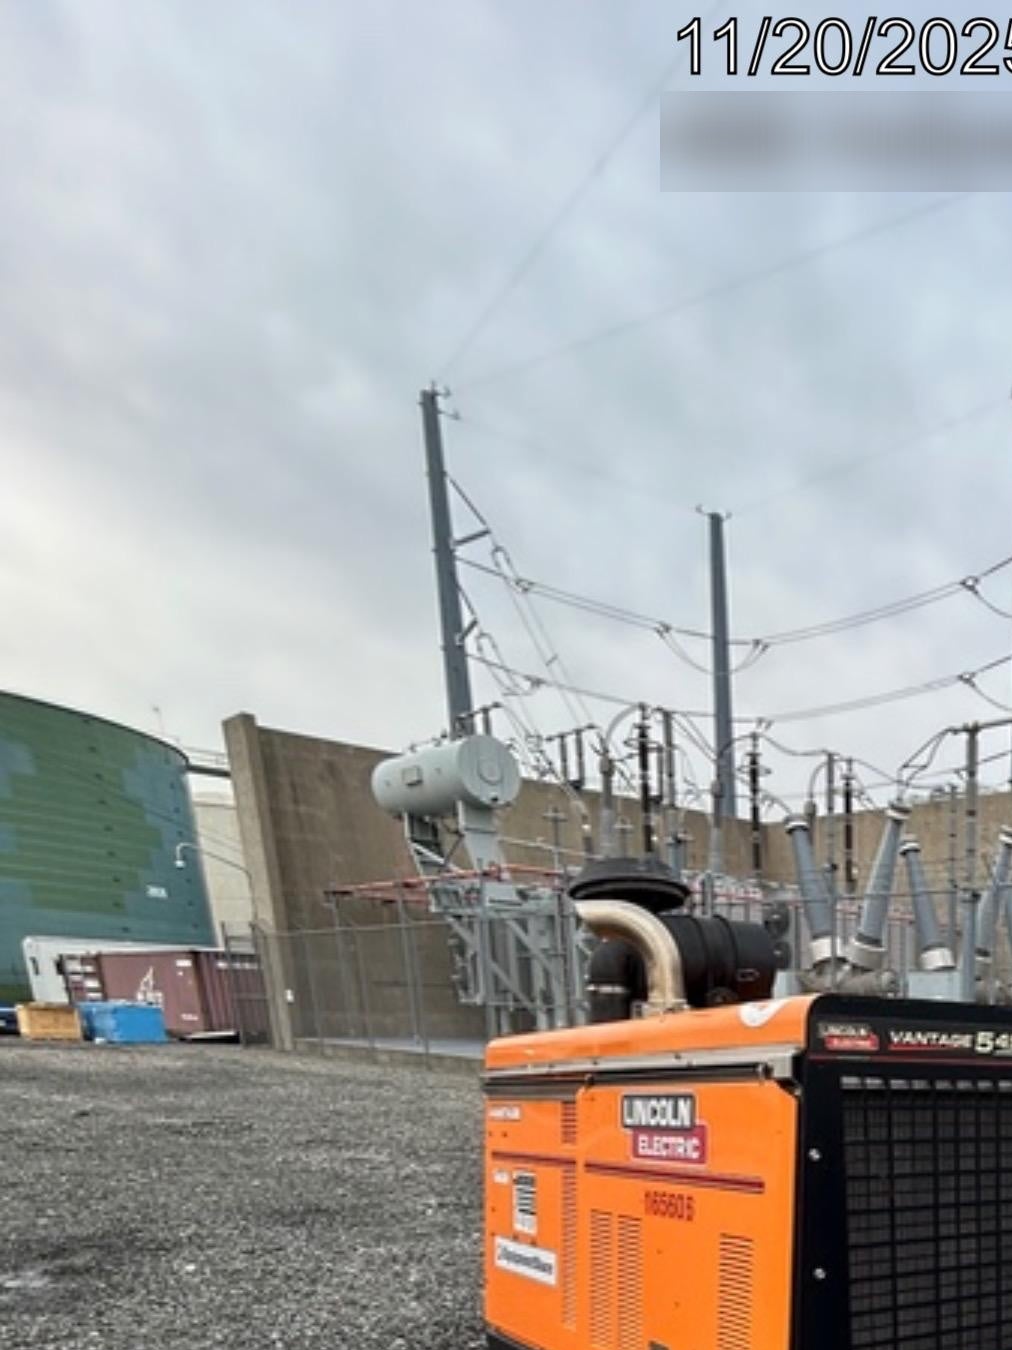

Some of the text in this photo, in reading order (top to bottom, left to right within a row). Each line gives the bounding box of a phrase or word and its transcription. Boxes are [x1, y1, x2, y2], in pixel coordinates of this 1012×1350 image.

[889, 1030, 972, 1048] VANTAGE
[623, 1097, 692, 1126] LINCOLN
[638, 1134, 700, 1159] ELECTRIC
